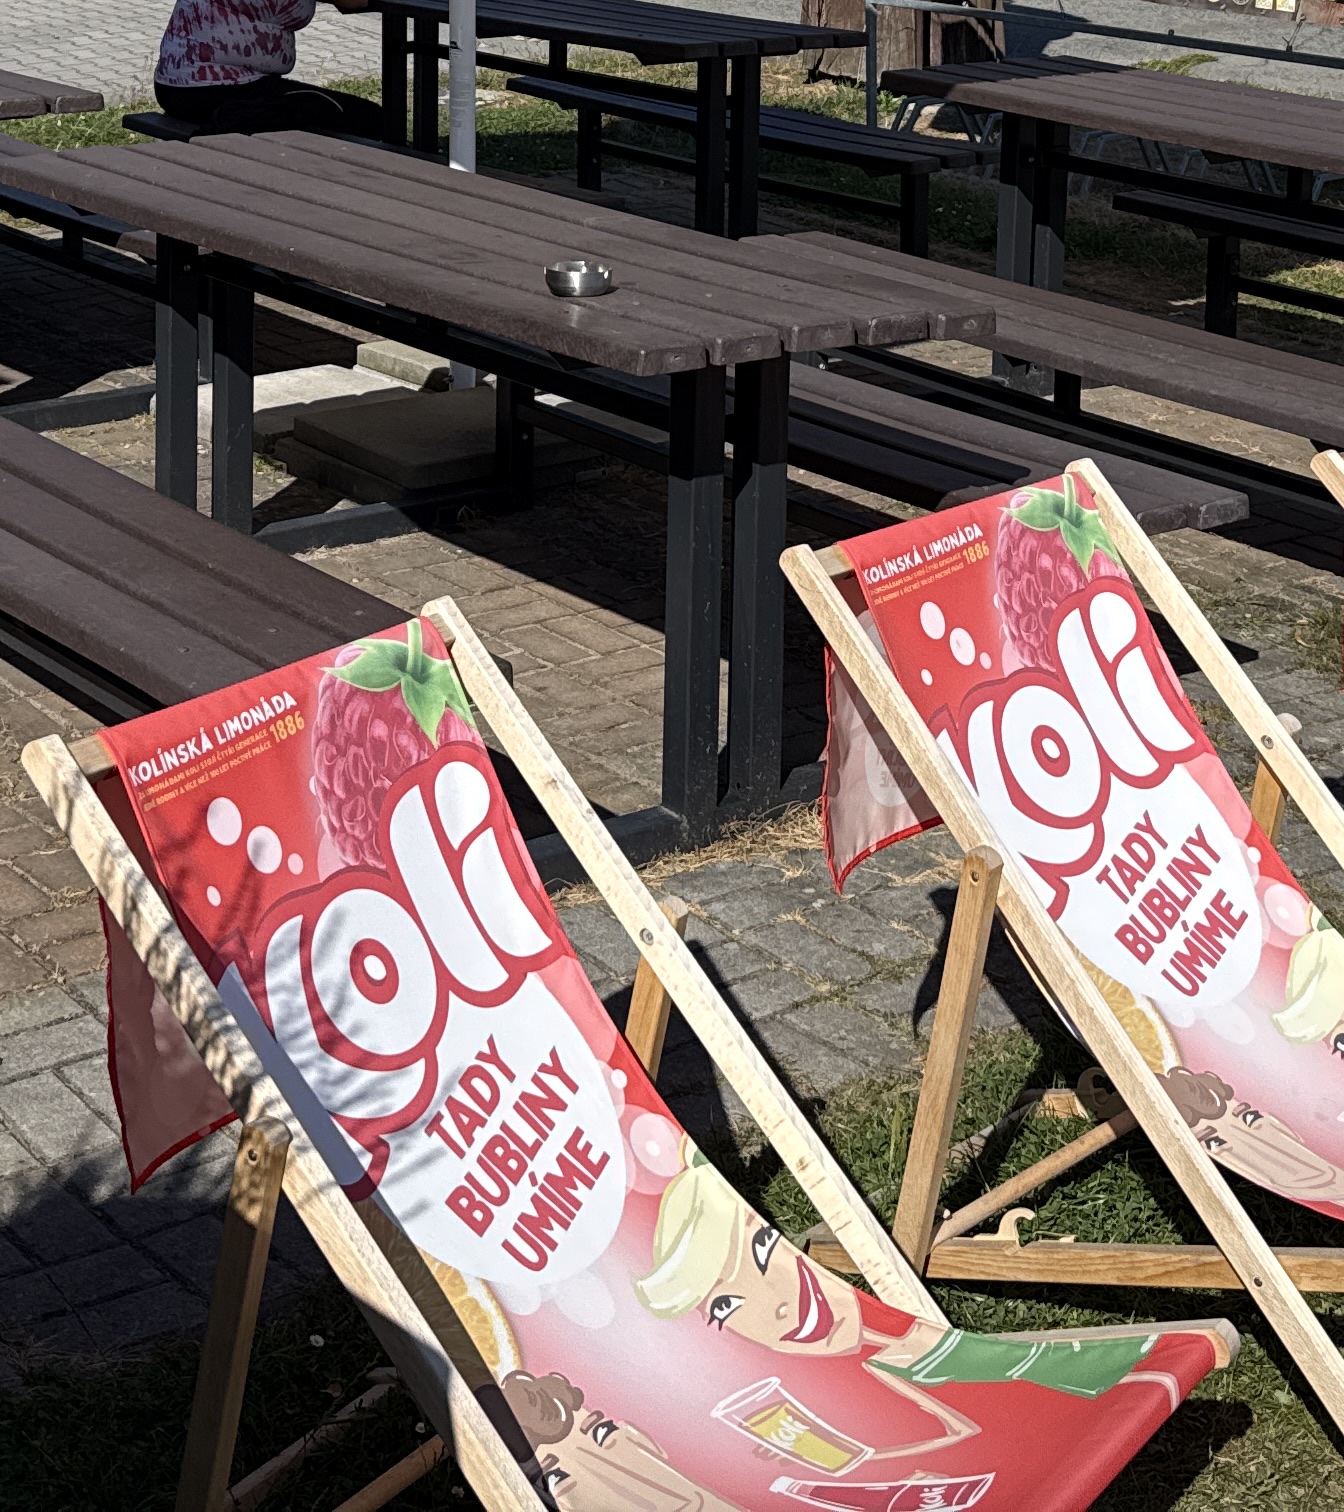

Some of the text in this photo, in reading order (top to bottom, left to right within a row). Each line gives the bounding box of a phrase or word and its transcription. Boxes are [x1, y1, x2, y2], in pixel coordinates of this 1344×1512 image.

[922, 523, 984, 562] LIMONÁDA
[962, 540, 990, 564] 1886
[128, 690, 298, 786] KOLÍNSKÁ LIMONÁDA
[269, 710, 305, 743] 1886
[1095, 810, 1169, 905] TADY
[1114, 824, 1221, 967] BUBLINY
[1160, 890, 1249, 997] UMÍME
[425, 1033, 522, 1159] TADY
[445, 1046, 579, 1237] BUBLINY
[501, 1128, 610, 1272] UMÍME
